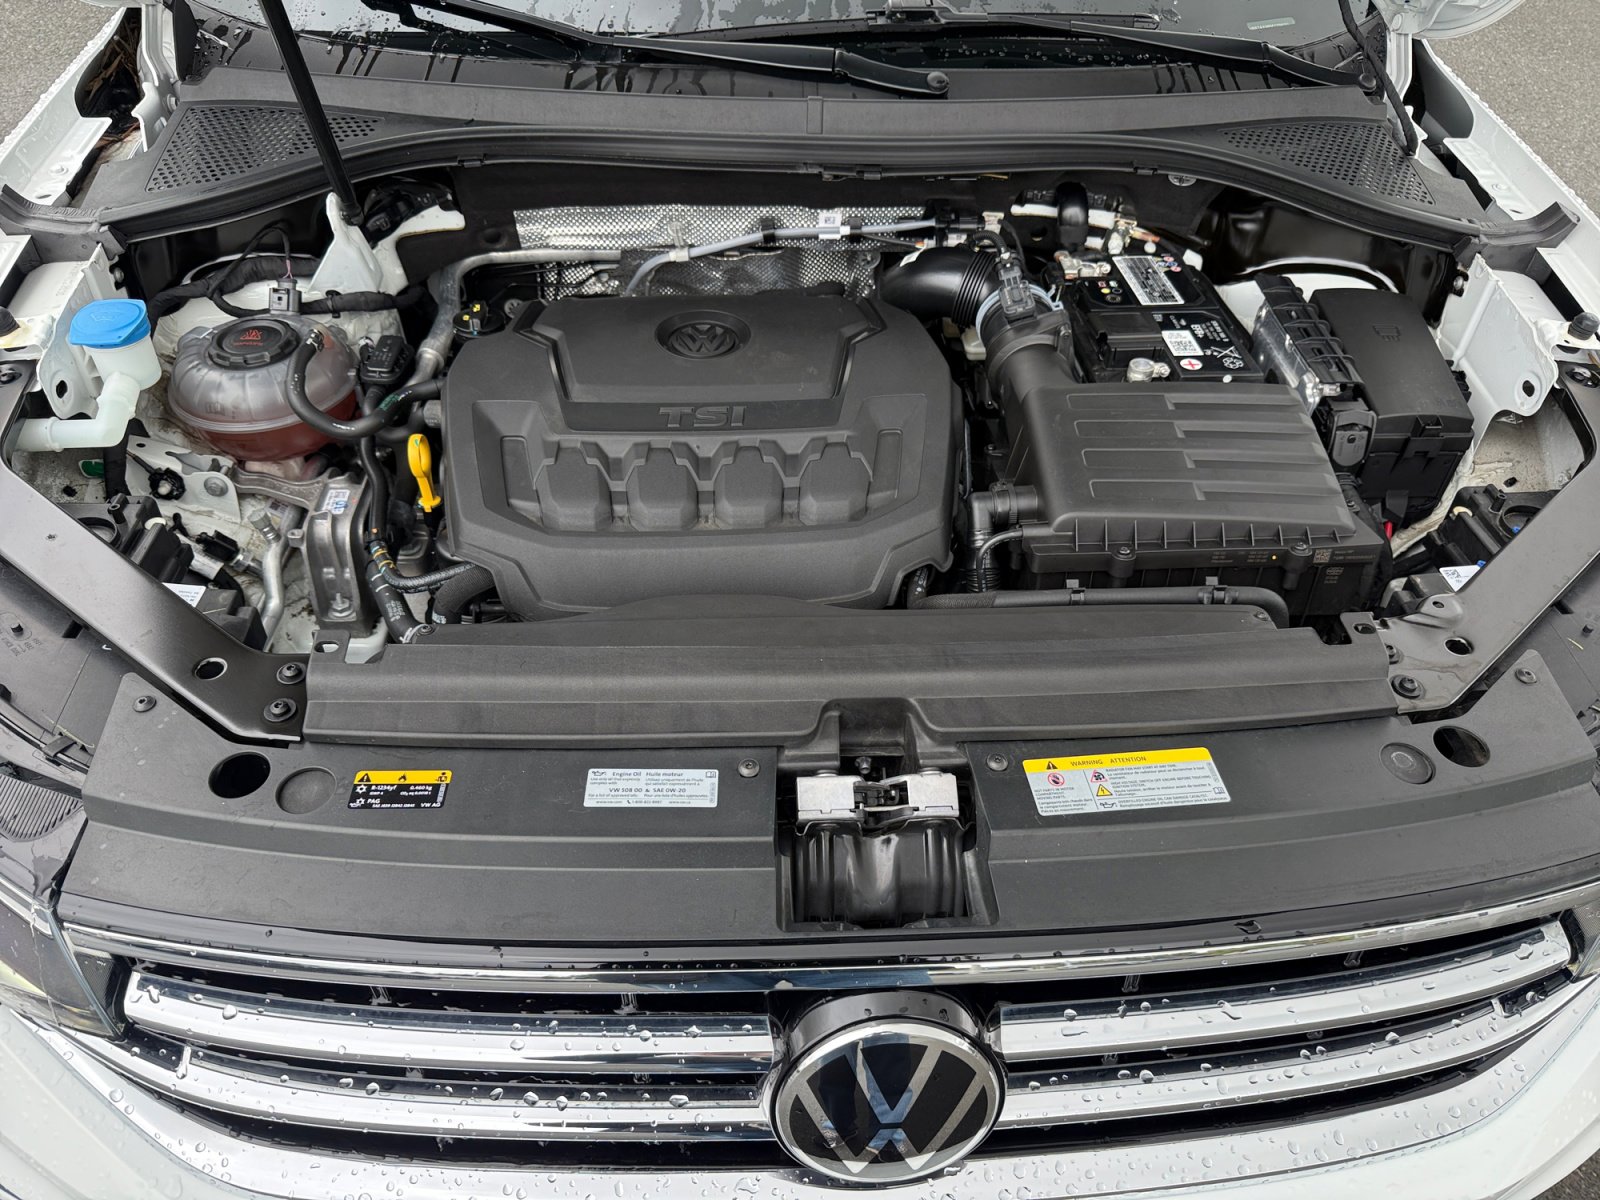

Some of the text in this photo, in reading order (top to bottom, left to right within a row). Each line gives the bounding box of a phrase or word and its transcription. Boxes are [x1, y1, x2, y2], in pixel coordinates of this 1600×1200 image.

[669, 321, 739, 356] VW
[659, 406, 747, 427] TSI
[782, 1028, 994, 1177] VW
